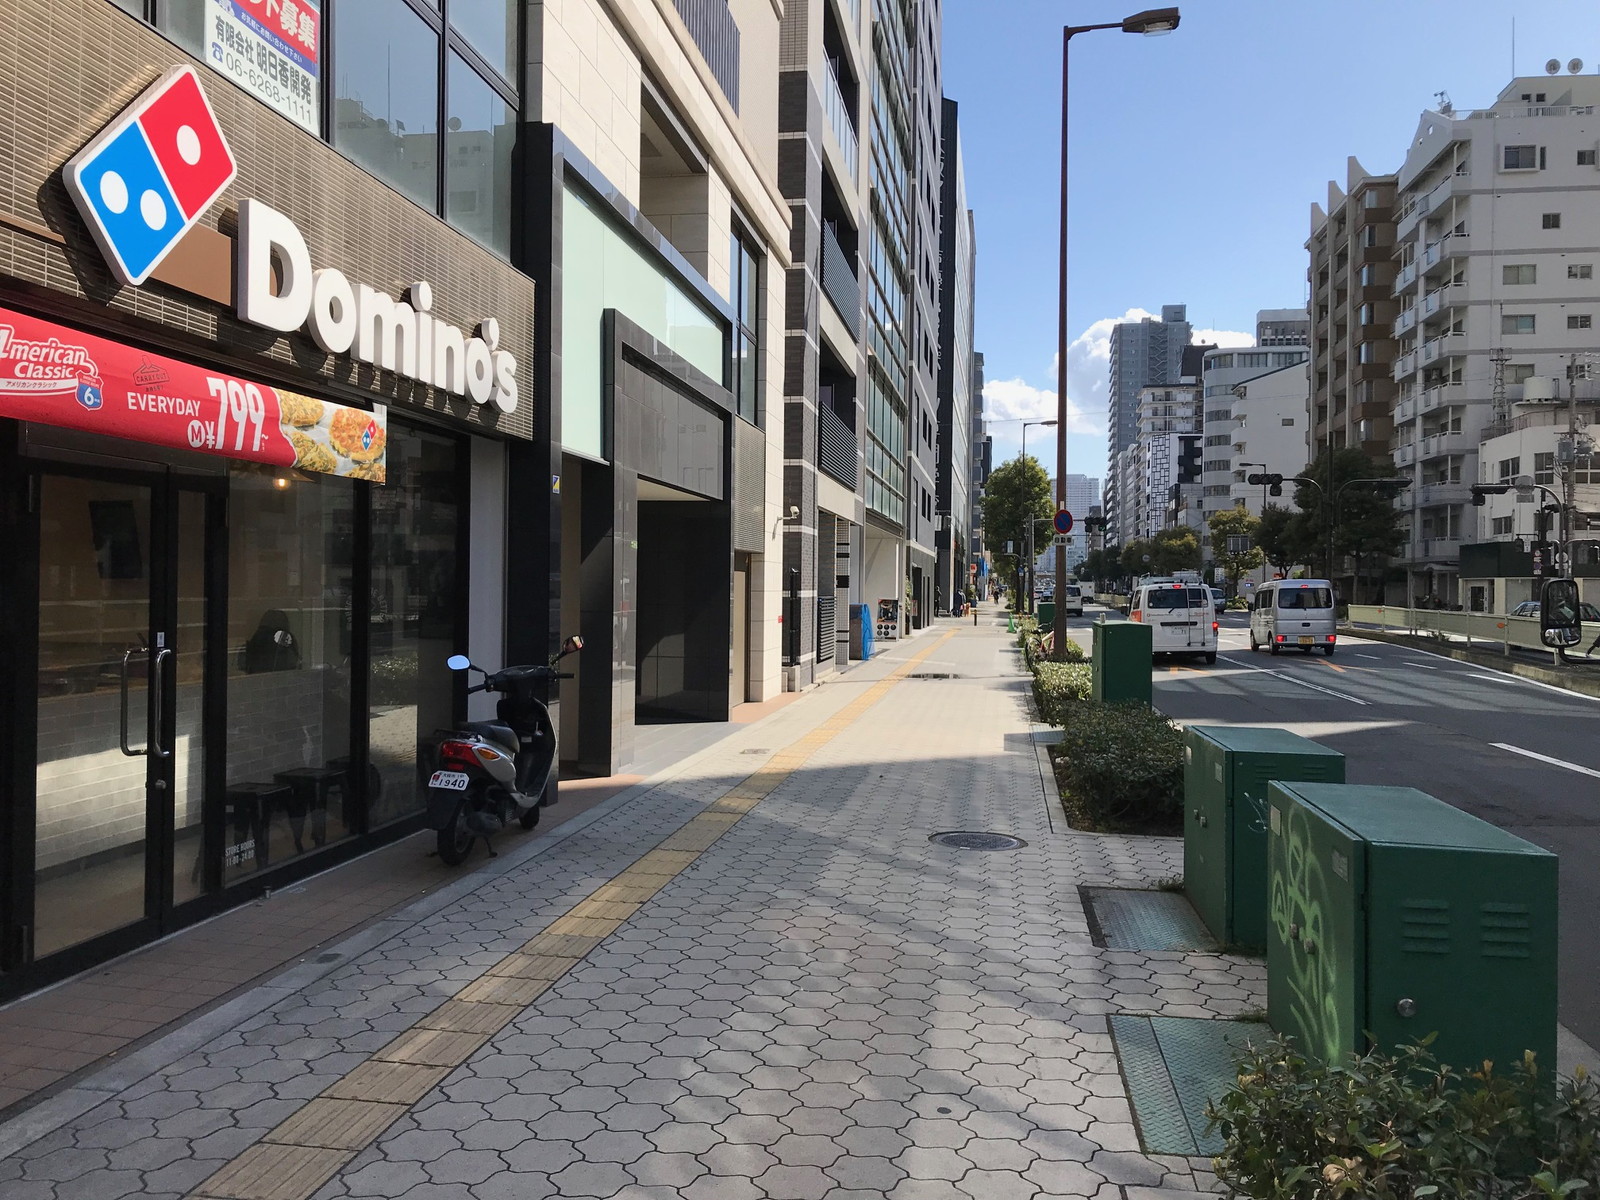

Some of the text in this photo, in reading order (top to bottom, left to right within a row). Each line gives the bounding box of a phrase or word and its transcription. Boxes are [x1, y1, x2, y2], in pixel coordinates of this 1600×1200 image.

[226, 52, 312, 125] 06-6268-1111
[238, 198, 518, 414] Domino's
[14, 361, 74, 379] Classic
[84, 386, 94, 406] 6
[127, 391, 201, 417] EVERYDAY
[439, 778, 465, 788] 1940
